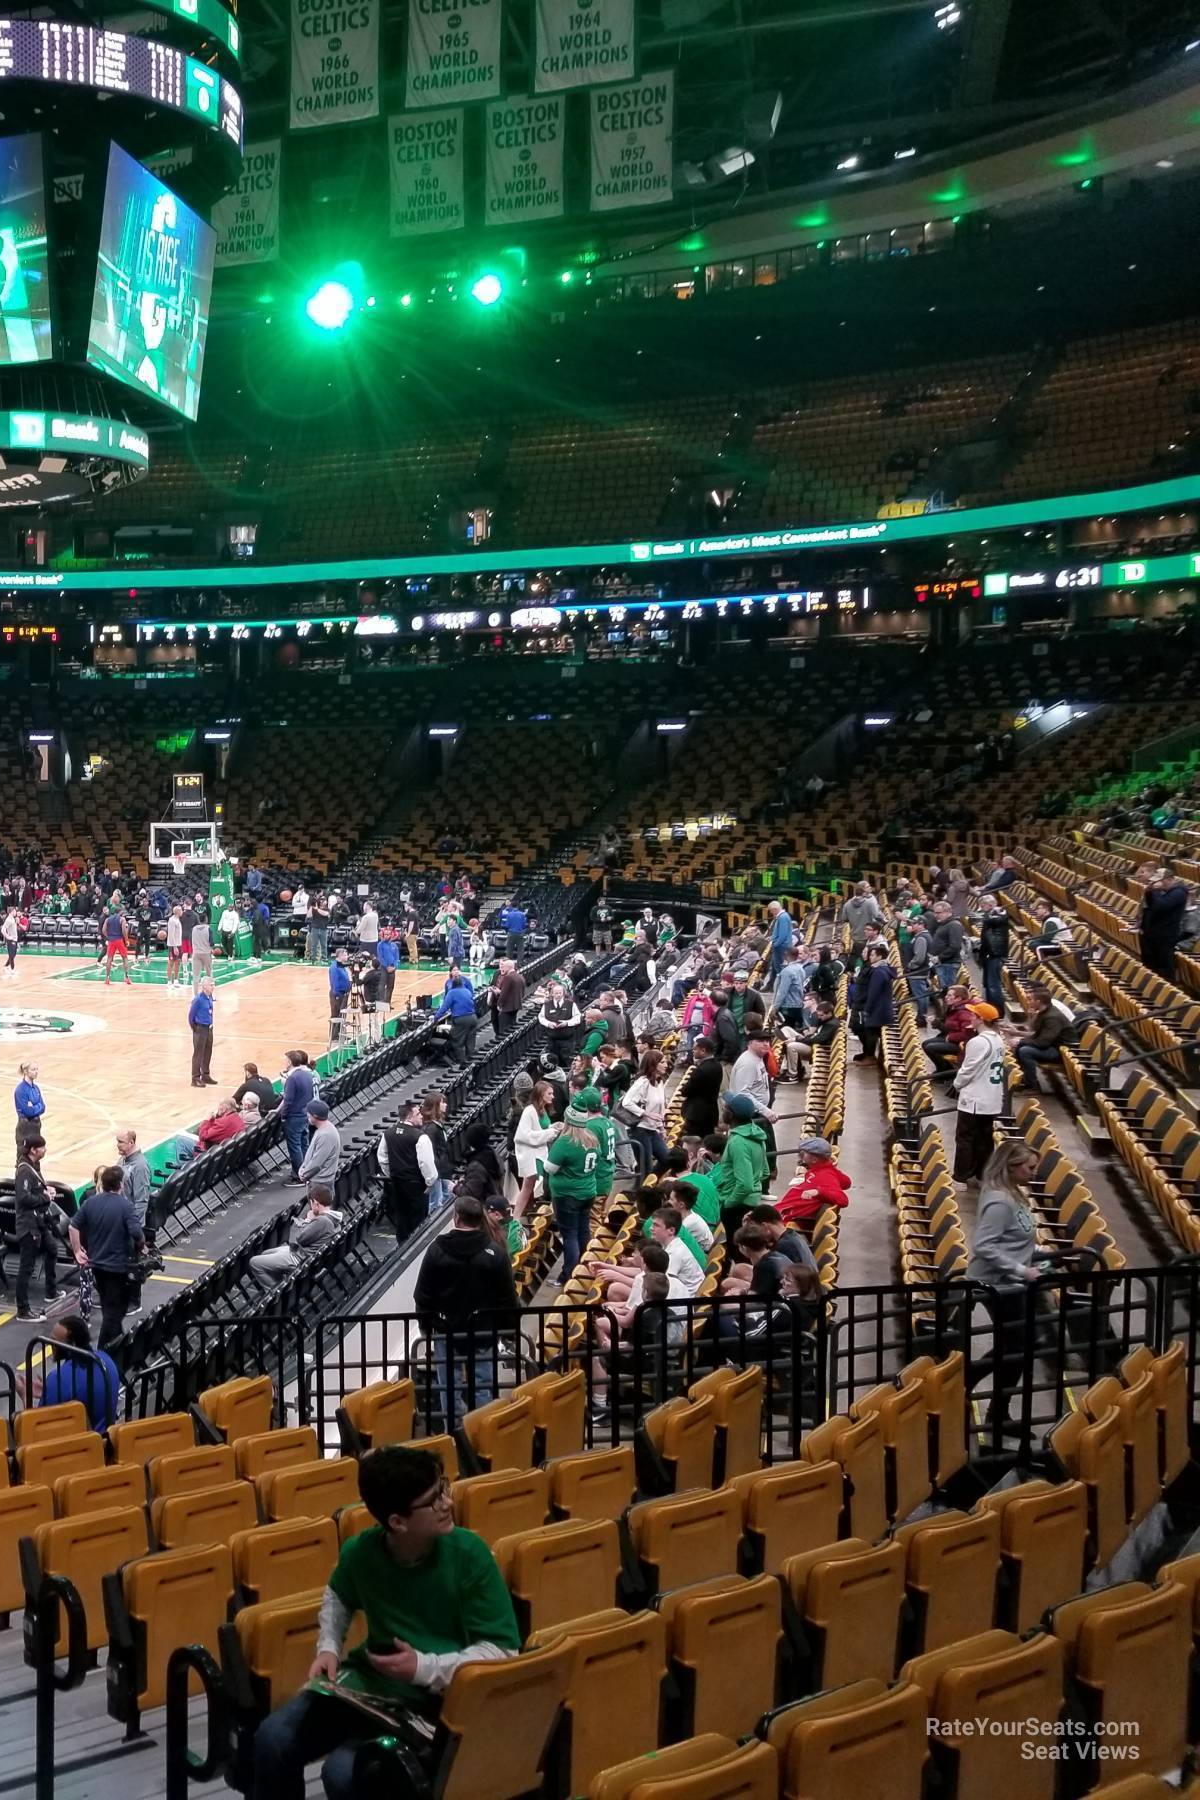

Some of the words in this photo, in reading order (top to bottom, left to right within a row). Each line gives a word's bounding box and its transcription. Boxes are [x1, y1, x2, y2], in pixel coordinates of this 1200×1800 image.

[301, 7, 370, 38] CELTICS
[569, 14, 600, 31] 1964
[439, 32, 469, 50] 1965
[560, 29, 611, 50] WORLD
[320, 56, 350, 73] 1966
[428, 50, 478, 71] WORLD
[541, 45, 628, 74] CHAMPIONS
[312, 72, 358, 92] WORLD
[413, 66, 494, 92] CHAMPIONS
[296, 87, 374, 113] CHAMPIONS
[597, 85, 667, 113] BOSTON
[492, 102, 560, 130] BOSTON
[600, 107, 664, 133] CELTICS
[394, 118, 458, 145] BOSTON
[495, 123, 557, 149] CELTICS
[396, 138, 455, 164] CELTICS
[620, 147, 646, 161] 1957
[243, 153, 275, 172] TON
[512, 163, 537, 177] 1959
[609, 161, 653, 179] WORLD
[230, 173, 273, 195] LTICS
[414, 176, 439, 189] 1960
[504, 177, 547, 195] WORLD
[595, 175, 667, 197] CHAMPIONS
[407, 191, 447, 208] WORLD
[490, 190, 560, 213] CHAMPIONS
[235, 210, 255, 223] 1961
[395, 206, 460, 226] CHAMPIONS
[227, 224, 264, 240] WORLD
[215, 236, 275, 255] CHAMPIONS
[136, 226, 156, 284] US
[154, 233, 180, 288] RISE
[51, 418, 98, 442] Bank
[699, 537, 750, 553] America's
[782, 529, 848, 545] Convenient
[1055, 567, 1099, 587] 6:31
[1121, 564, 1145, 581] TD
[584, 1153, 597, 1173] 0
